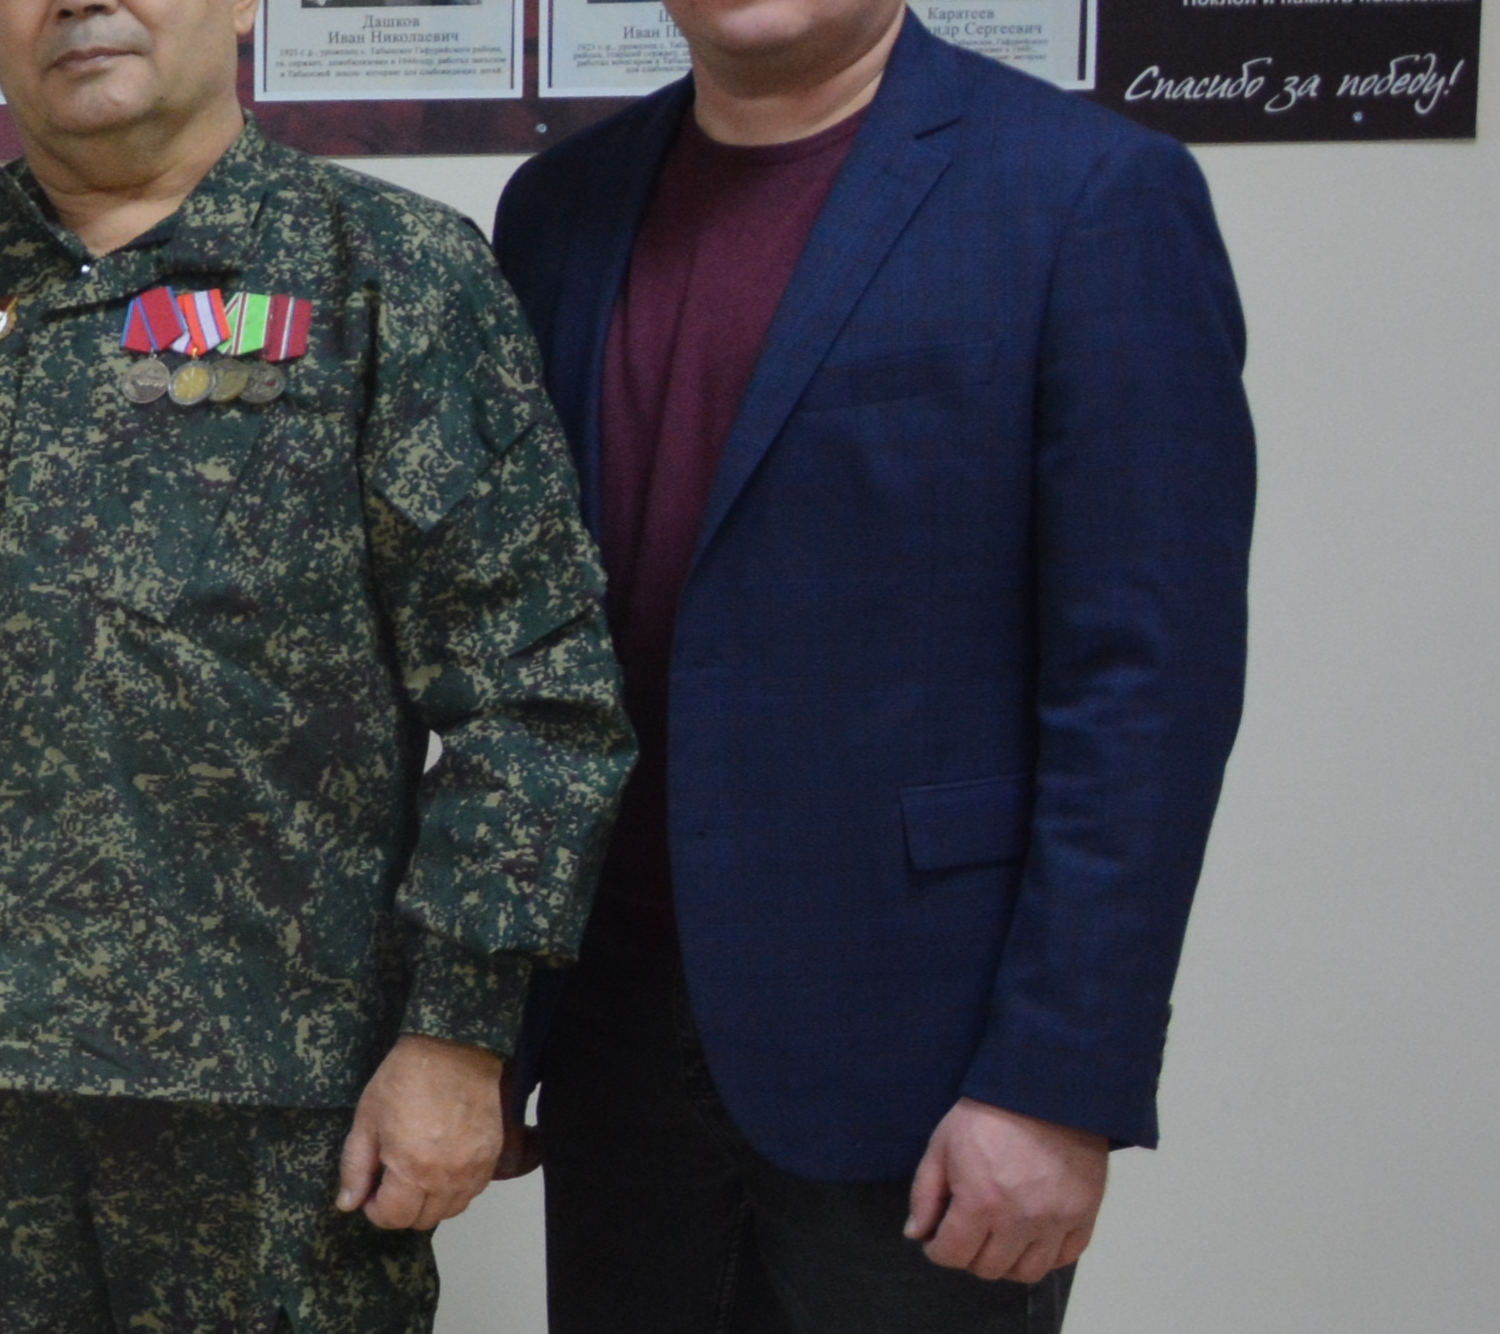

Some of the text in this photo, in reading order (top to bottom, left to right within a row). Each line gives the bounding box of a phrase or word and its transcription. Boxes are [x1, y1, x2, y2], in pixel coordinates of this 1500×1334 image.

[362, 14, 421, 30] Дашков
[964, 21, 1042, 36] Сергеевич
[328, 30, 460, 45] Иван Николаевич
[622, 26, 660, 40] Иван
[1124, 53, 1466, 115] Спасибо за победу!
